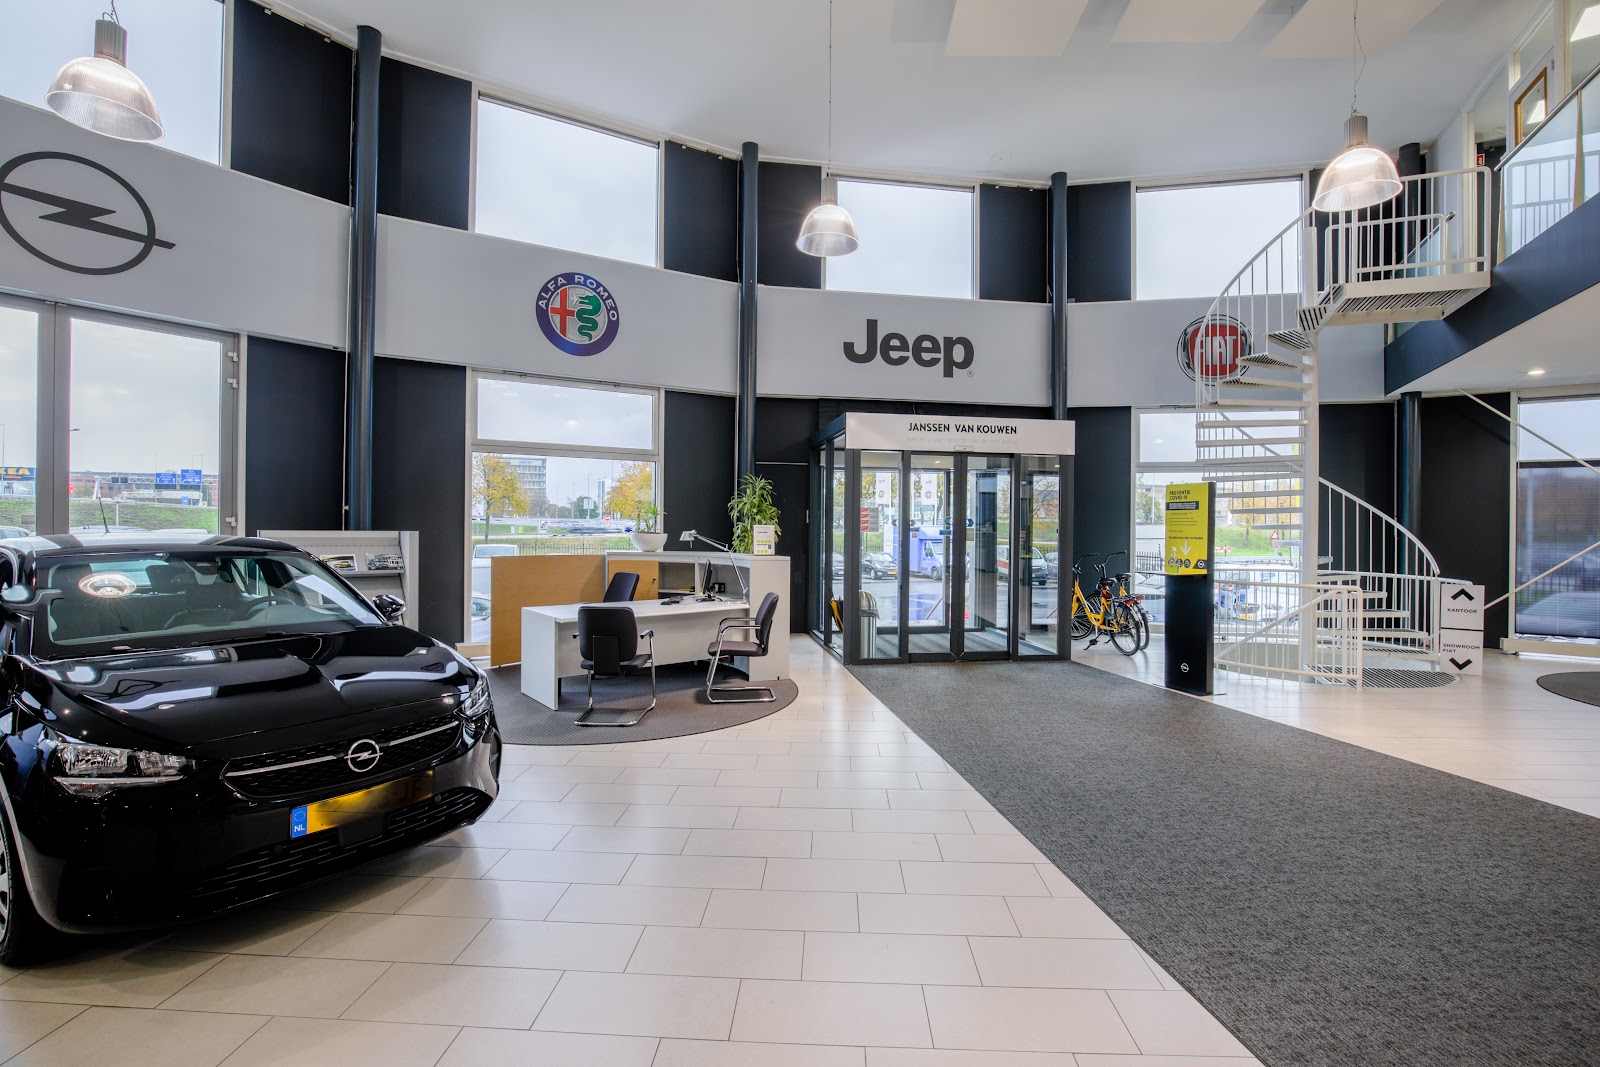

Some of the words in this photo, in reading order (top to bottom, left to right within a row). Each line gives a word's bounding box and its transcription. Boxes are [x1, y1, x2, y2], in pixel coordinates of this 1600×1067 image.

[538, 276, 567, 310] ALFA
[574, 274, 618, 321] ROMEO
[843, 318, 975, 379] Jeep
[1195, 335, 1237, 366] IAT
[908, 422, 950, 432] JANSSEN
[955, 424, 974, 433] VAN
[976, 424, 1017, 434] KOUWEN
[294, 823, 306, 833] NL
